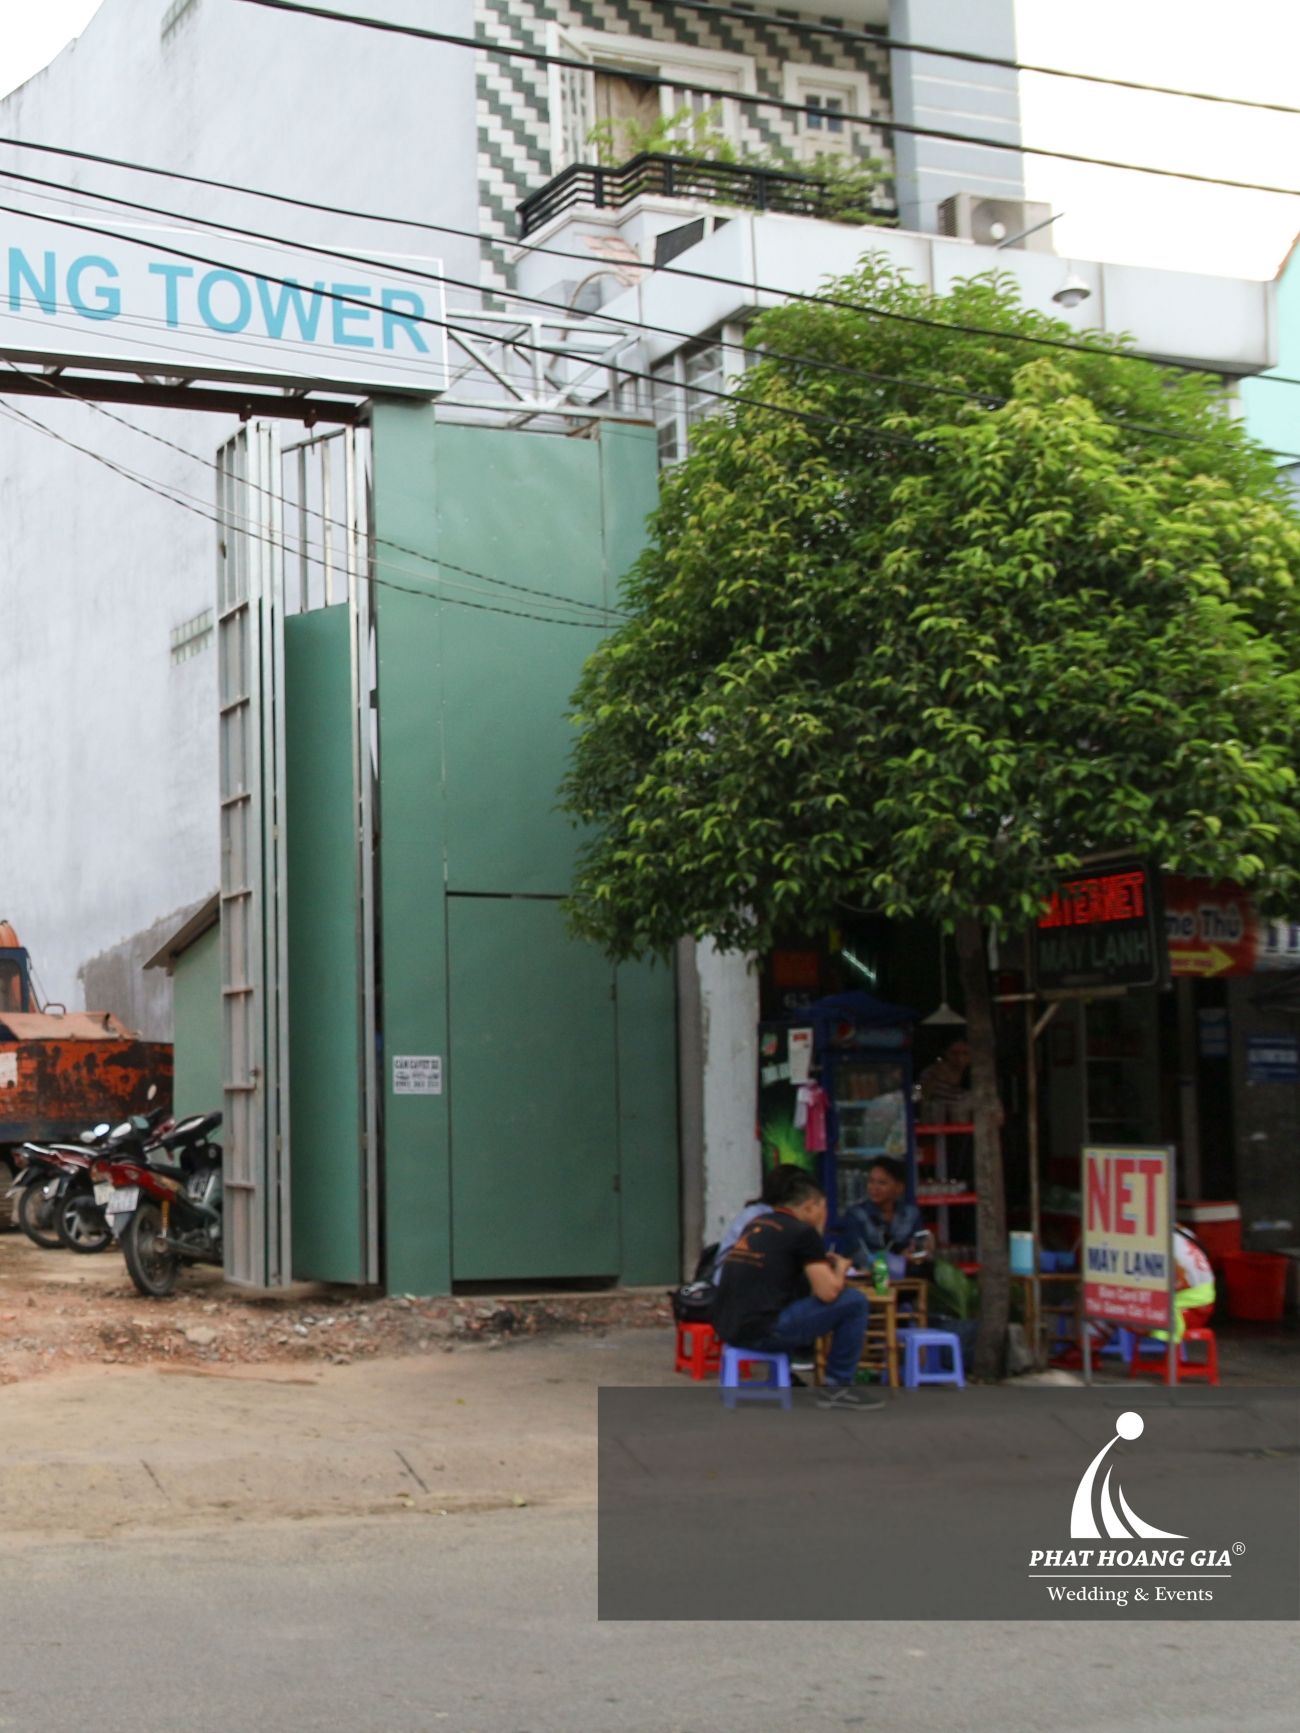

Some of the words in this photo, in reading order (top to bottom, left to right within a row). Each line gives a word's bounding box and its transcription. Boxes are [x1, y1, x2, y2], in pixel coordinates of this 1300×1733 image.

[148, 262, 430, 354] TOWER
[1087, 1156, 1164, 1237] NET
[1087, 1242, 1119, 1273] MÁY
[1123, 1251, 1166, 1282] LẠNH
